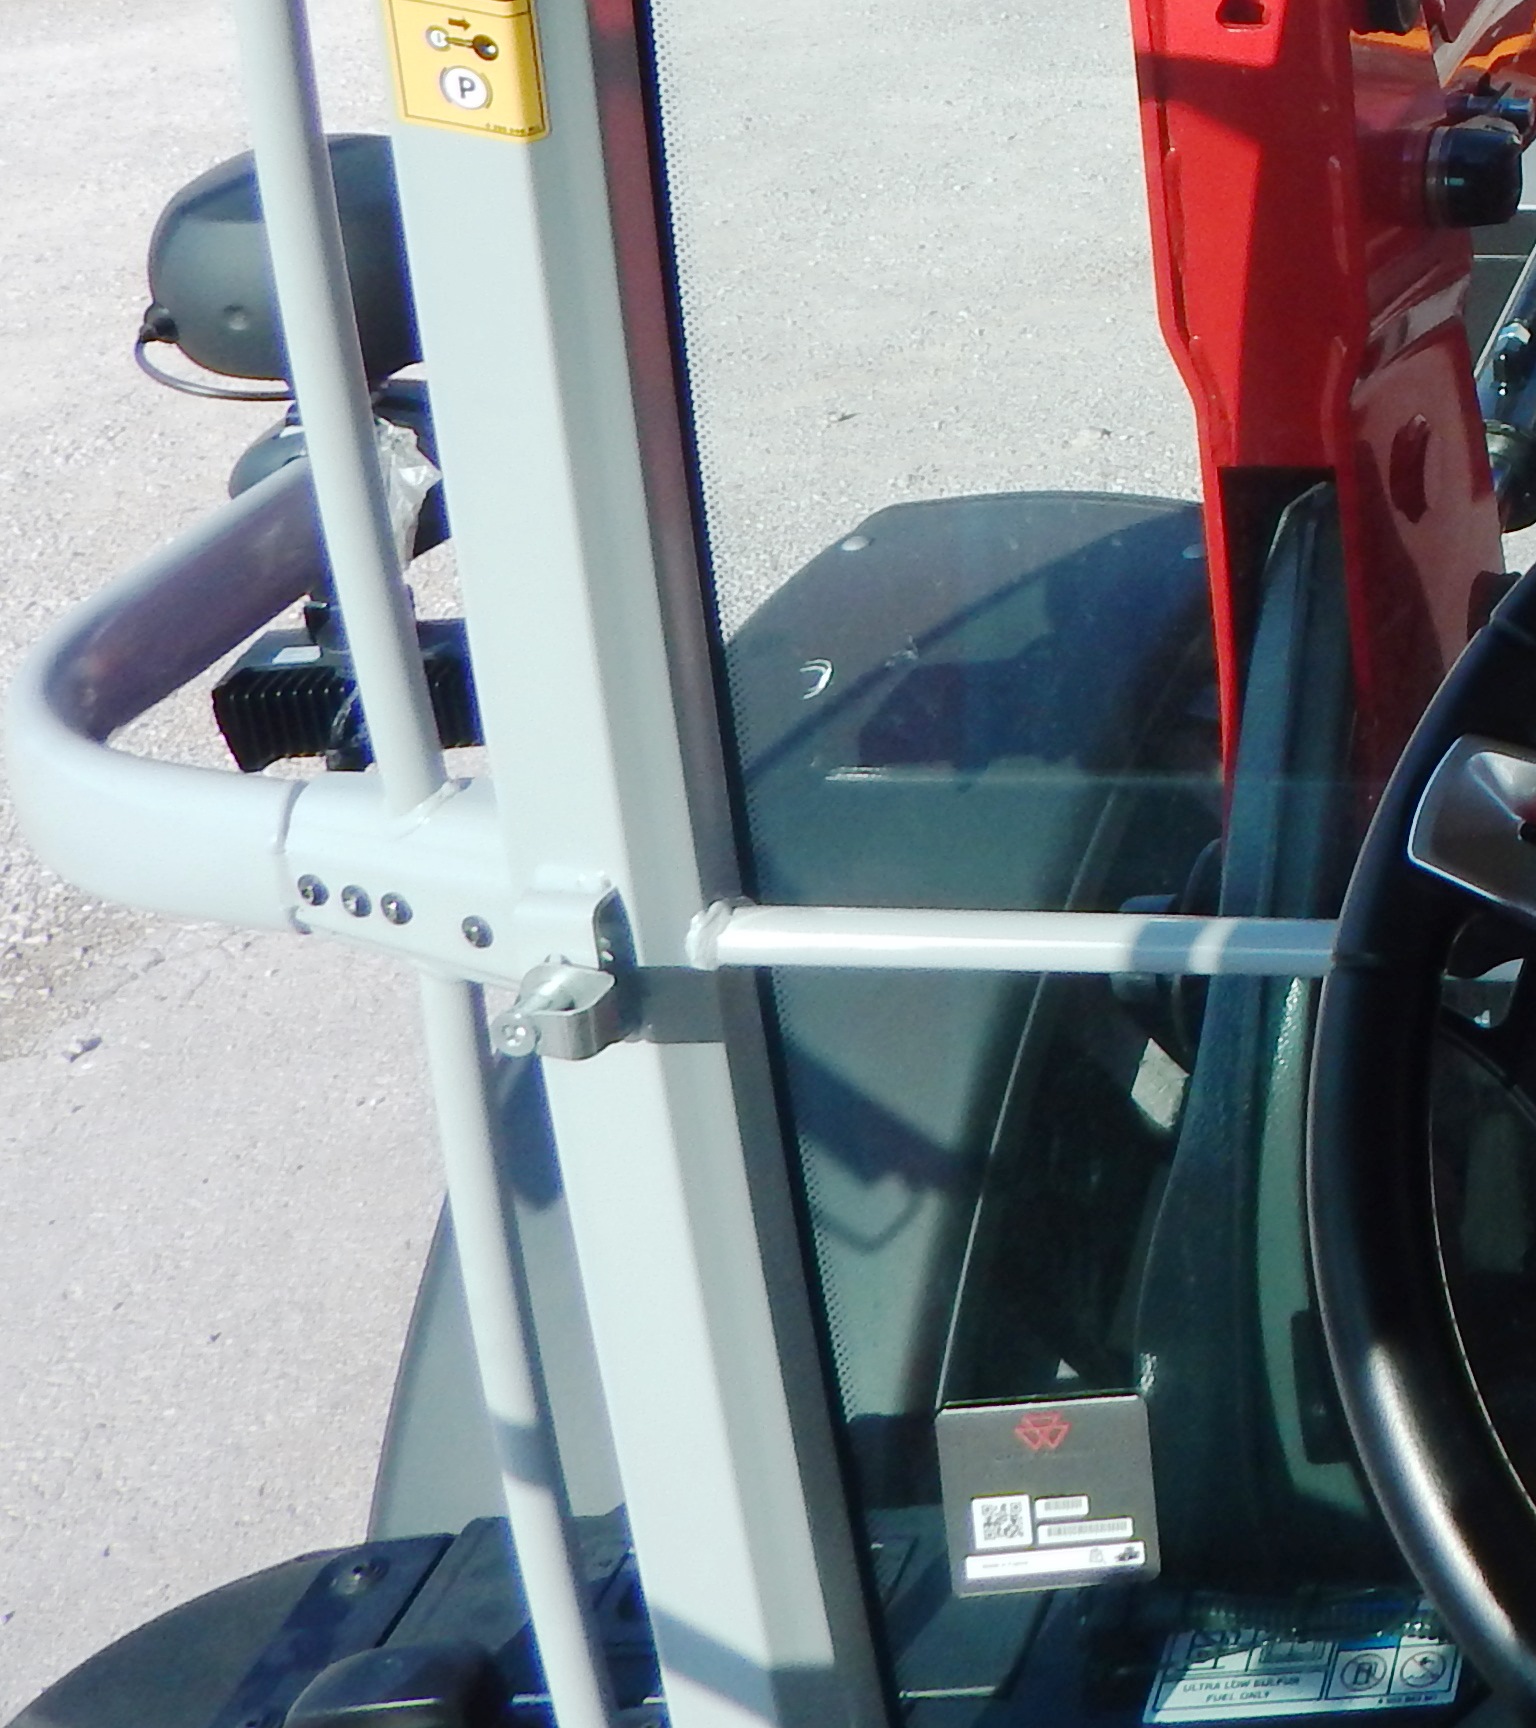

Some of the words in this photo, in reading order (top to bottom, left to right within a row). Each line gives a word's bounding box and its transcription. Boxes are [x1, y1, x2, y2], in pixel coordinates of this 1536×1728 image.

[458, 76, 476, 99] P
[1183, 1679, 1221, 1693] ULTRA
[1224, 1678, 1252, 1690] LOW
[1206, 1692, 1235, 1703] FUEL
[1239, 1690, 1270, 1701] ONLY
